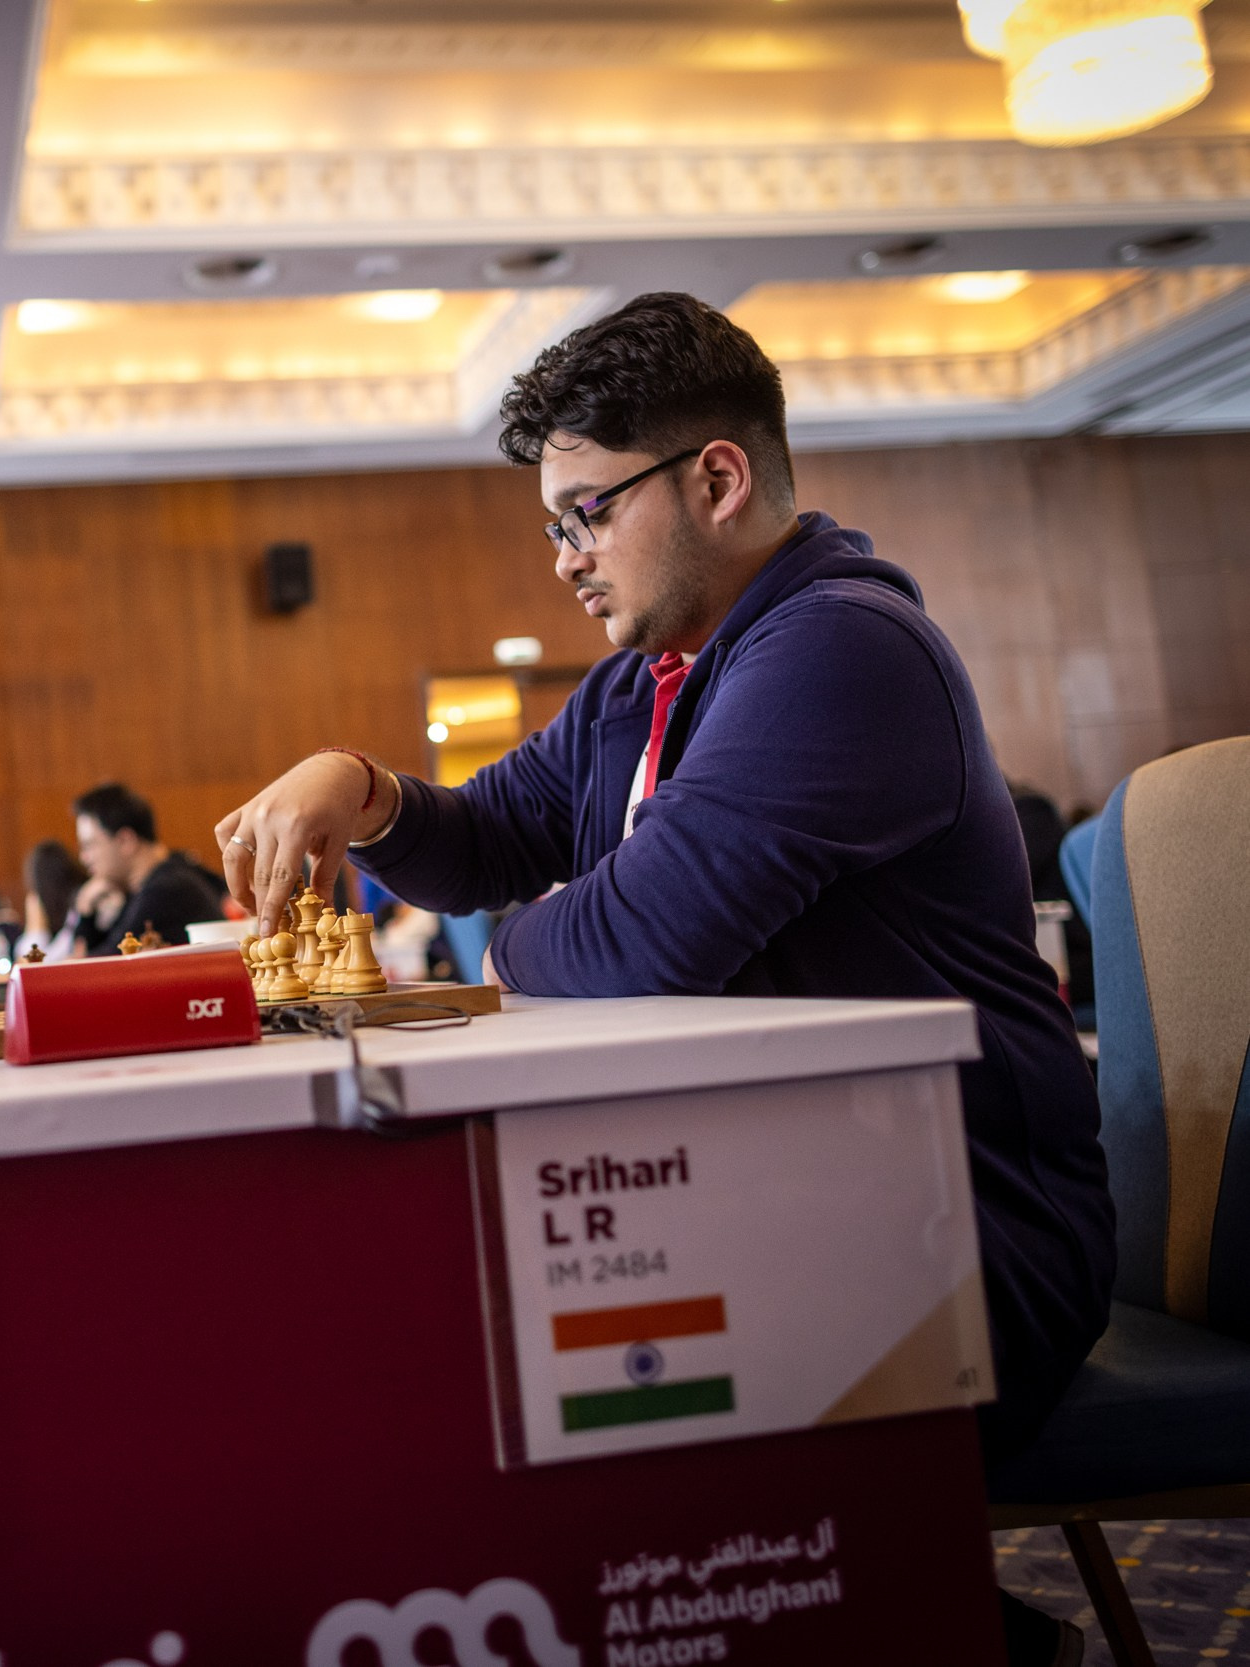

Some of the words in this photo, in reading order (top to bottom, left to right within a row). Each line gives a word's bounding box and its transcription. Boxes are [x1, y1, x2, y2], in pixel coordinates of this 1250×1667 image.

[186, 997, 225, 1020] DGT
[539, 1146, 689, 1197] Srihari
[543, 1210, 571, 1246] L
[584, 1205, 616, 1242] R
[546, 1258, 581, 1287] IM
[589, 1248, 667, 1284] 2484
[605, 1601, 642, 1636] Al
[648, 1569, 841, 1629] Abdulghani
[606, 1632, 727, 1667] Motors
